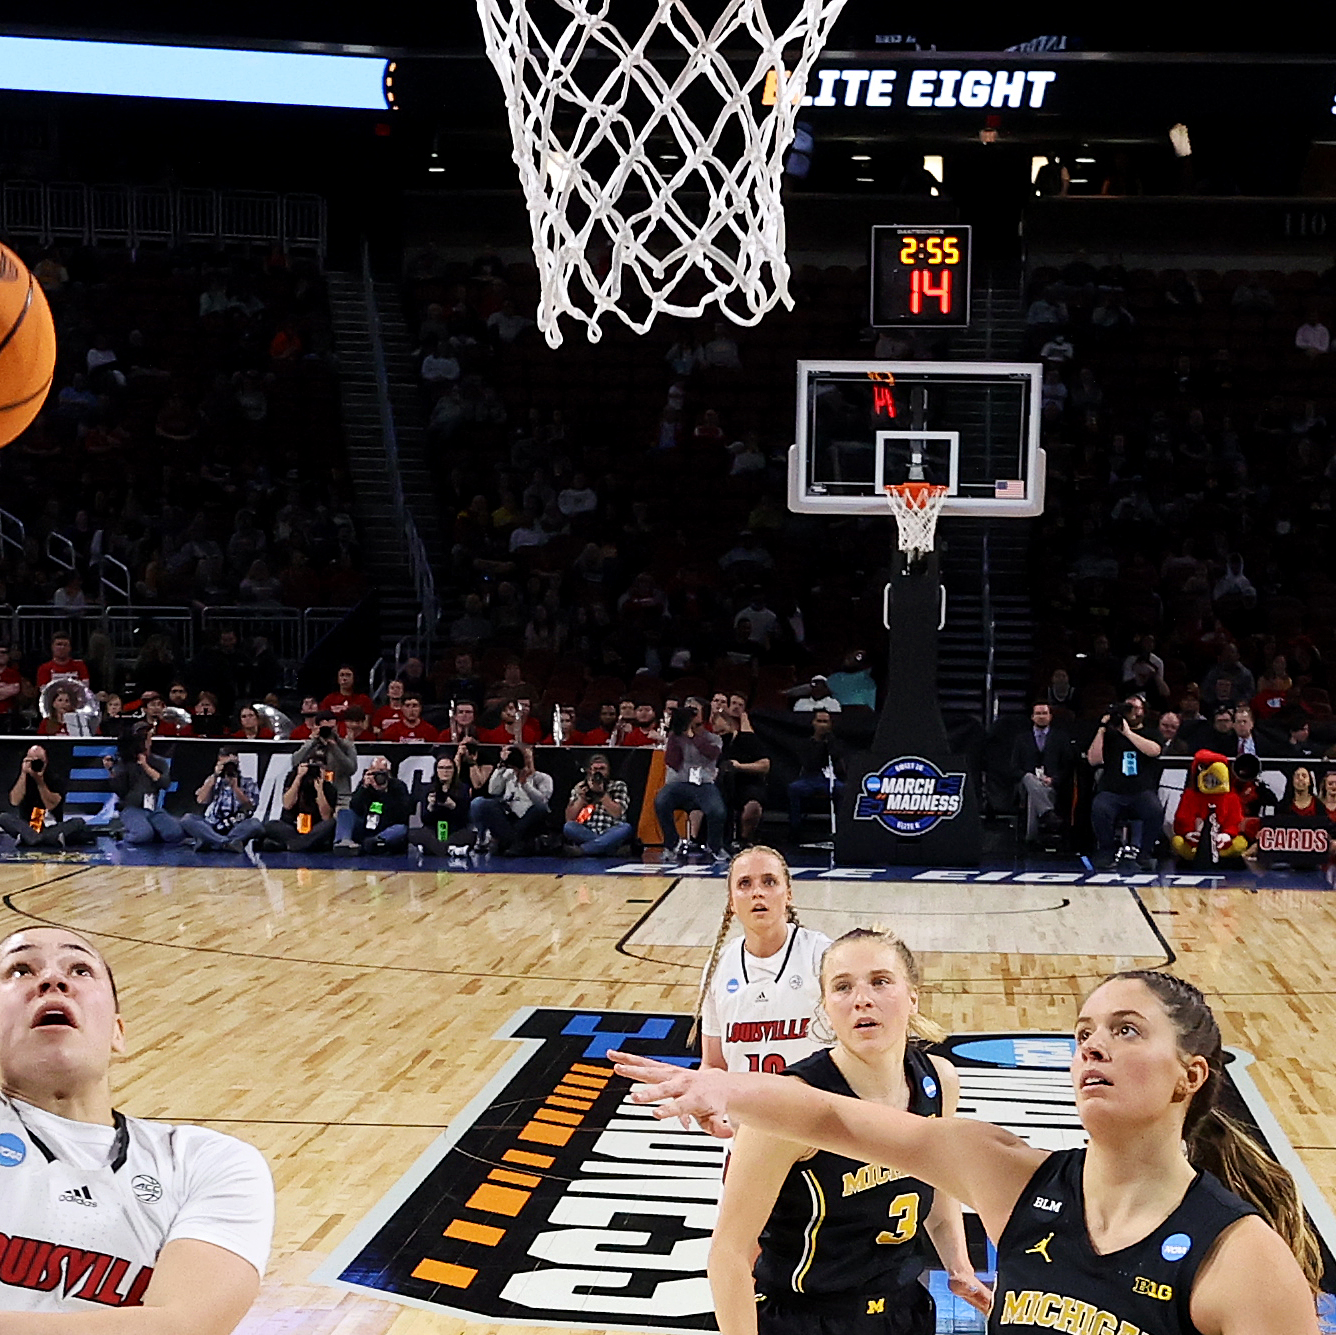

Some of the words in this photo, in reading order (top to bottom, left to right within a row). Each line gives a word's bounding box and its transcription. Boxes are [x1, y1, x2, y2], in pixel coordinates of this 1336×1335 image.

[906, 69, 1057, 108] EIGHT
[900, 236, 960, 265] 2:55
[910, 268, 952, 314] 14
[880, 777, 936, 795] MARCH
[886, 794, 960, 812] MADNESS
[1258, 827, 1329, 852] CARDS
[605, 863, 887, 879] ELTE
[912, 869, 1227, 886] EIGHT
[726, 1017, 811, 1043] LOUISVILLE
[1033, 1196, 1062, 1214] BLM
[875, 1192, 920, 1245] 3
[867, 1298, 885, 1315] M
